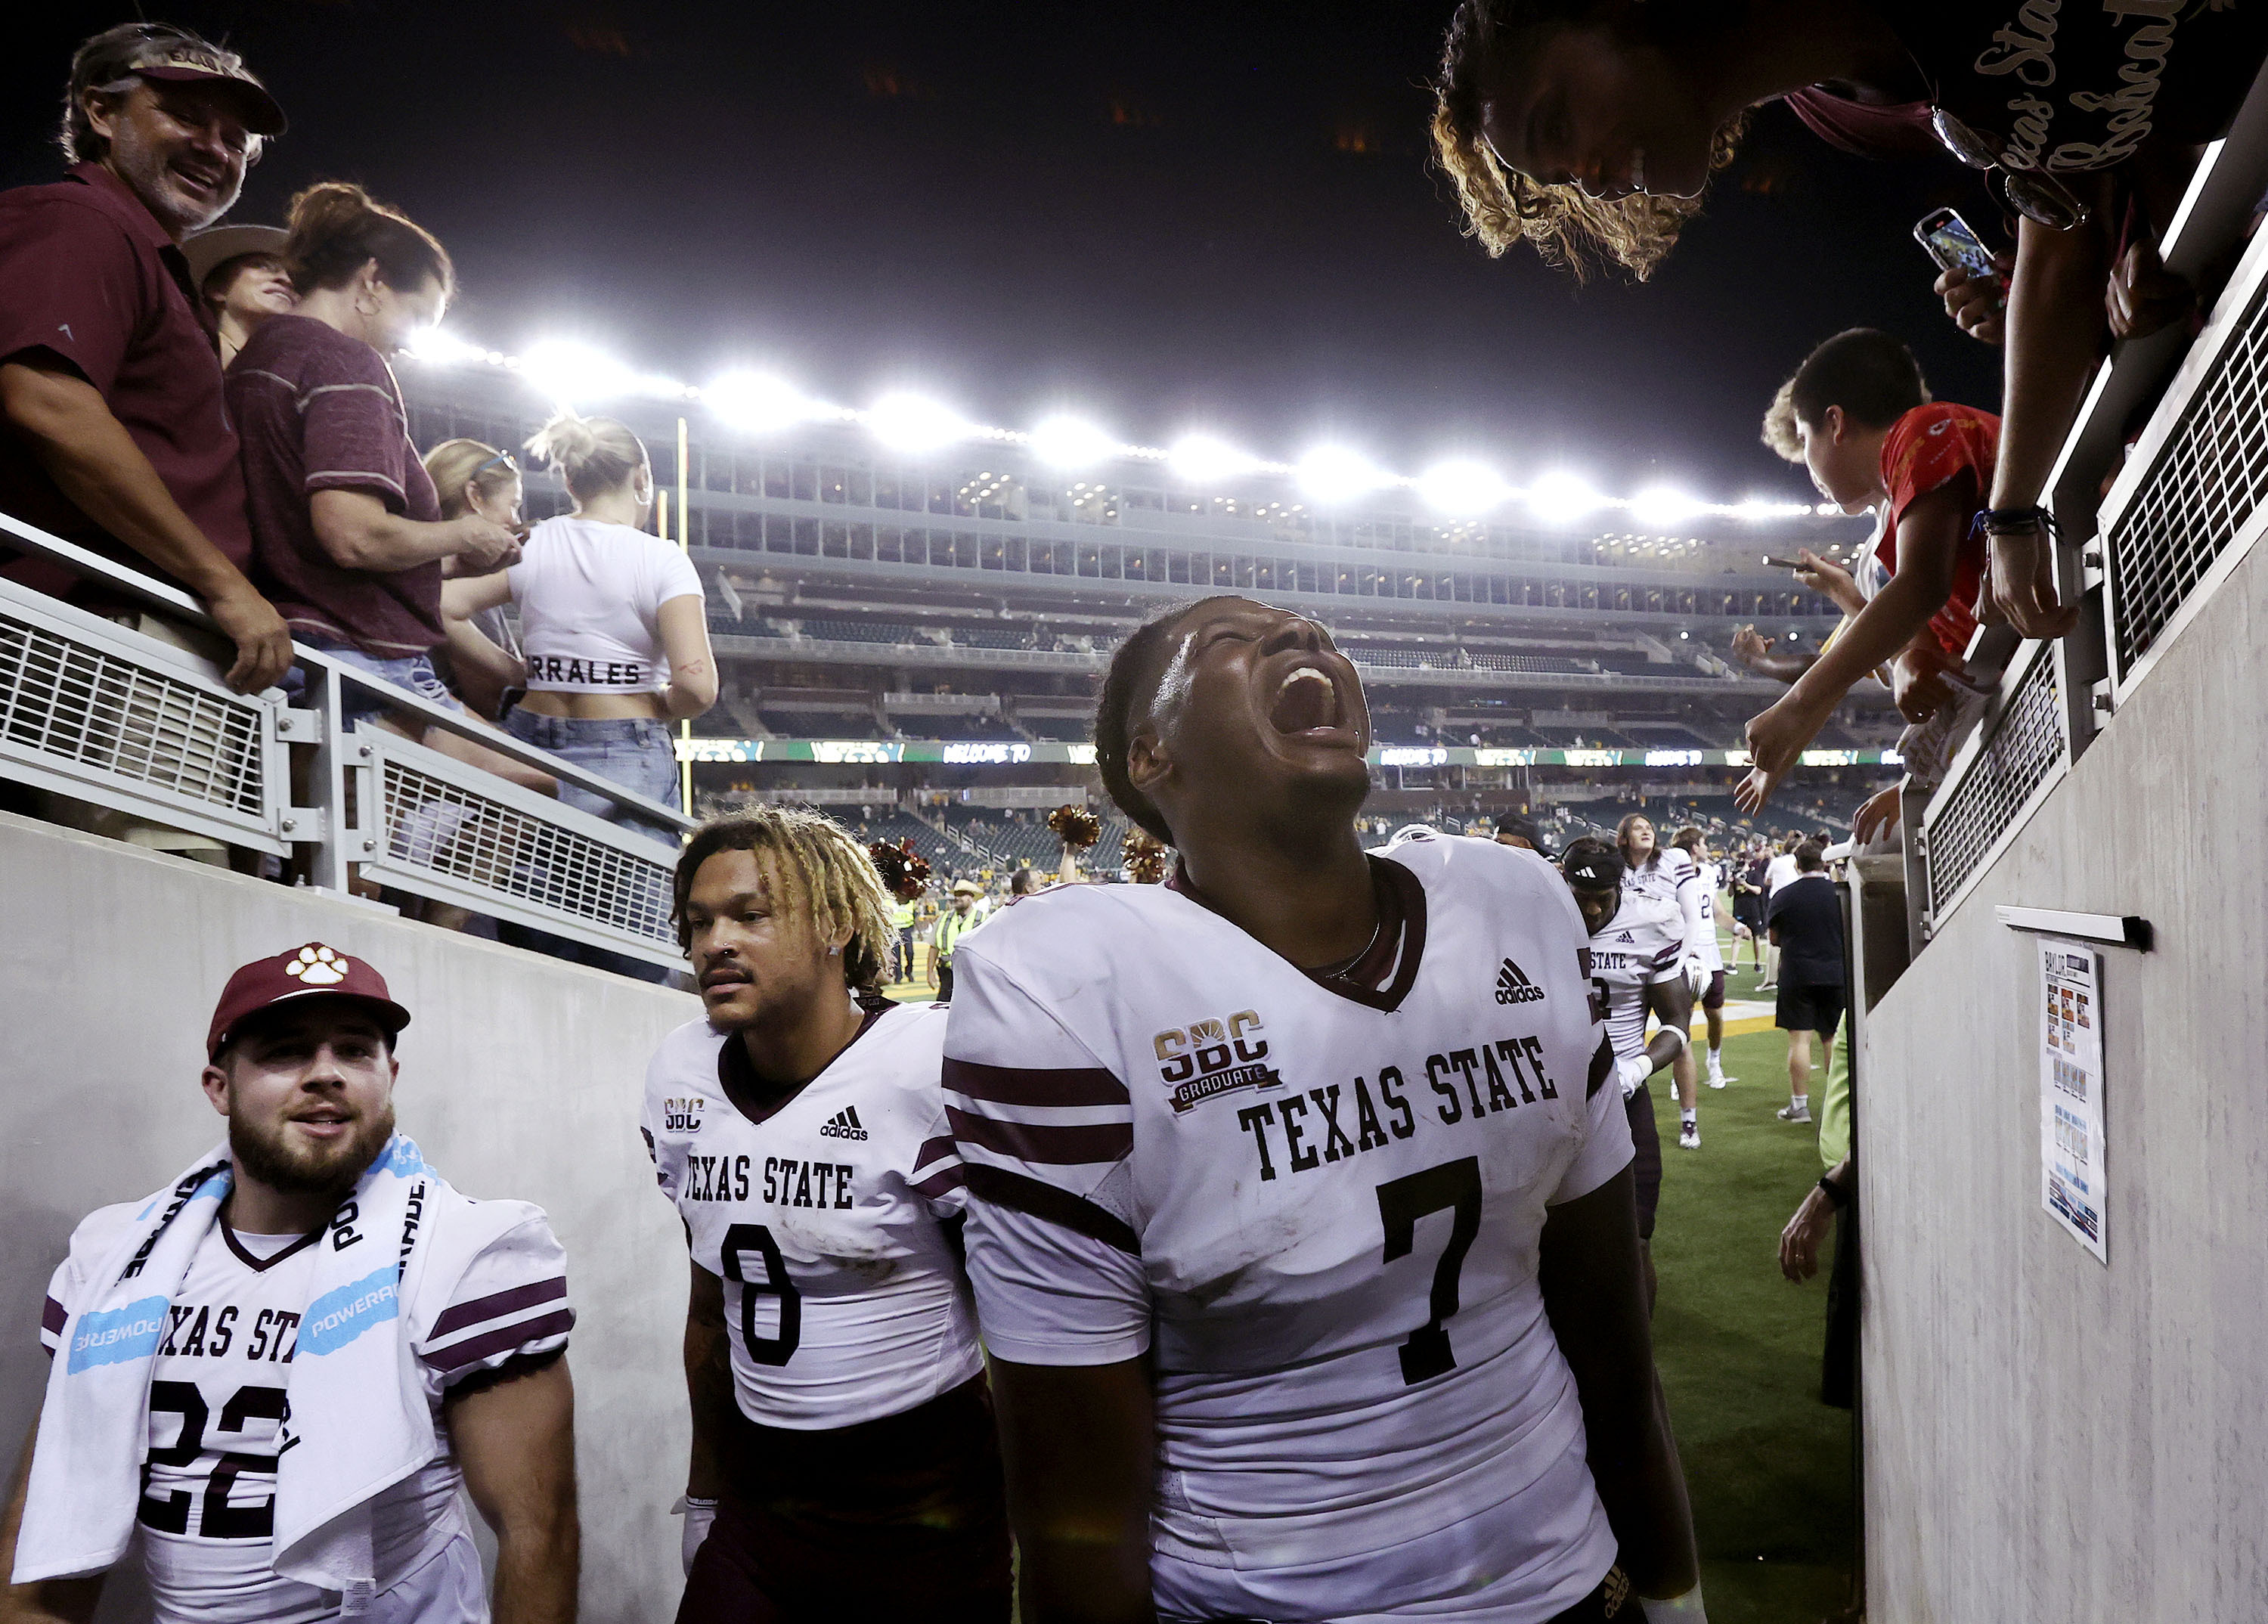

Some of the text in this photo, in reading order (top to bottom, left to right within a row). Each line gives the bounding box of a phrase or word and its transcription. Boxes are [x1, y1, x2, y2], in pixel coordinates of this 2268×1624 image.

[2000, 91, 2054, 170] exas
[527, 655, 640, 684] RRALES
[943, 743, 1031, 764] WELCOME TO
[1591, 951, 1626, 969] STATE
[1495, 984, 1545, 1005] adidas
[1152, 1009, 1271, 1084] SBC
[1178, 1066, 1266, 1102] GRADUATE
[1237, 1035, 1559, 1181] TEXAS STATE
[820, 1124, 869, 1142] adidas
[763, 1156, 854, 1210] STATE
[721, 1223, 801, 1368] 8
[1376, 1154, 1483, 1387] 7
[156, 1304, 240, 1359] XAS
[136, 1380, 291, 1539] 22
